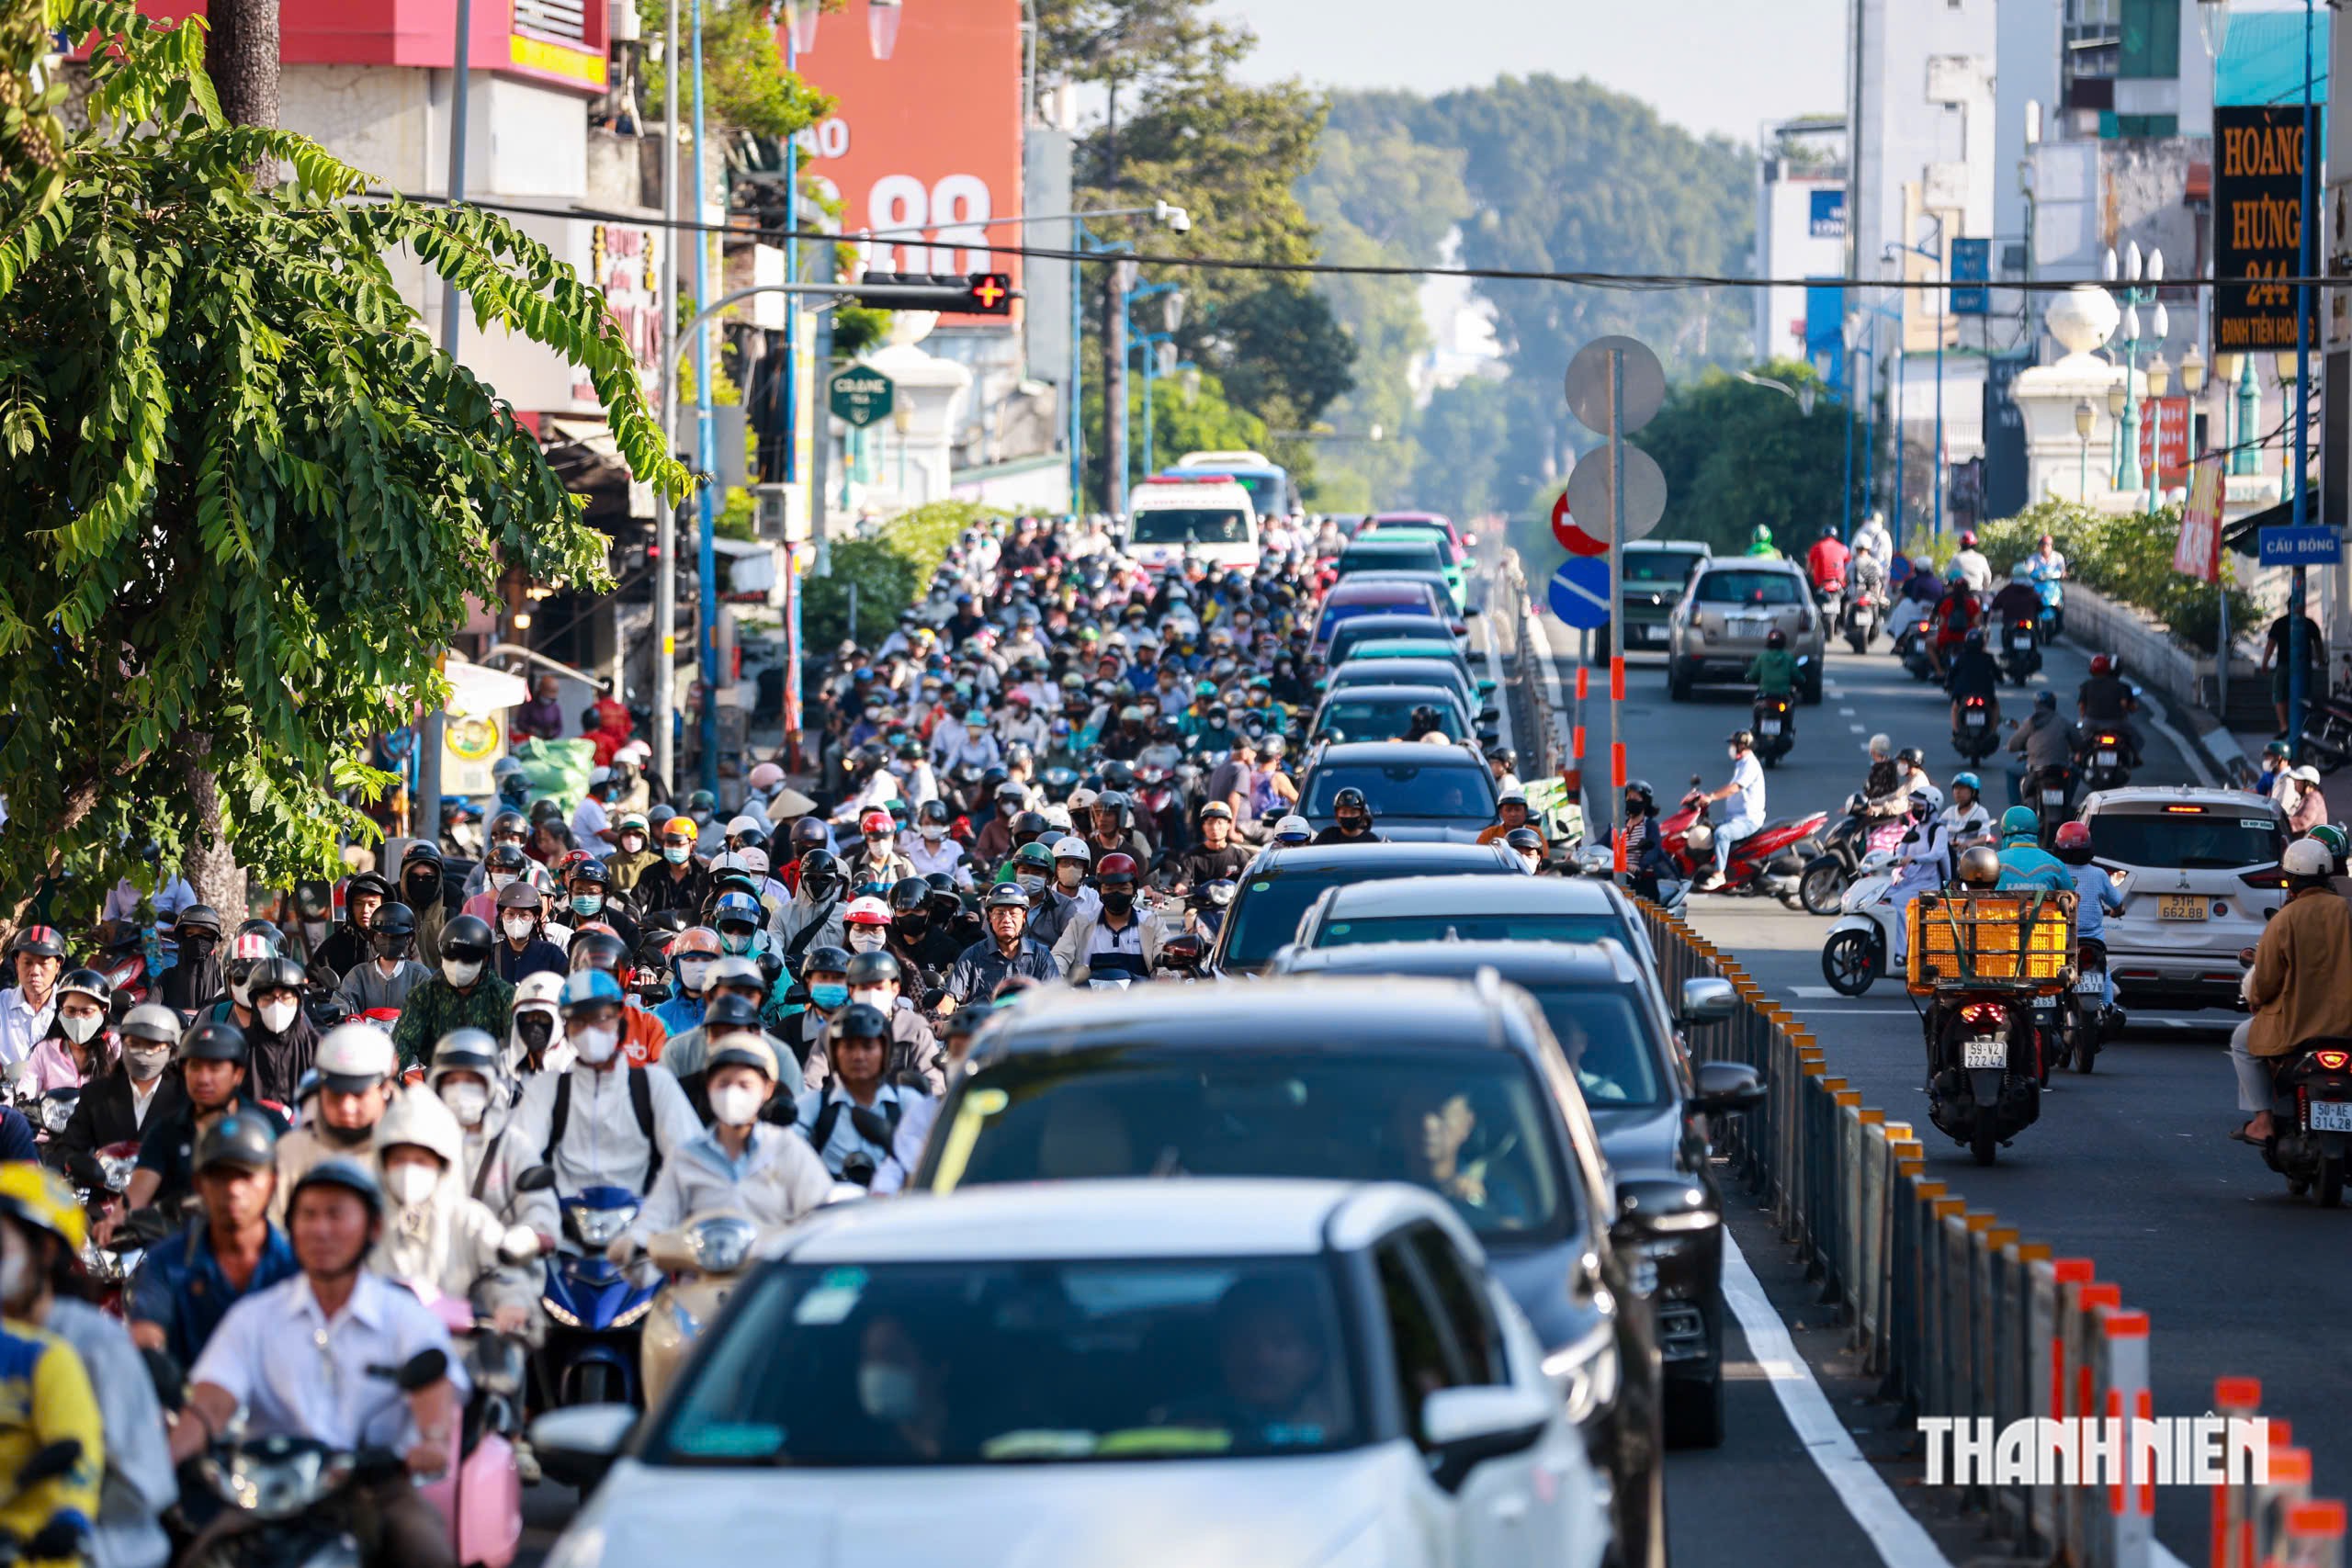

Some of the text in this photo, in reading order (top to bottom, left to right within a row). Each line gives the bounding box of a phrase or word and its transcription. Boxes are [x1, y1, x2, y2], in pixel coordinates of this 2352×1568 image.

[2245, 258, 2290, 307] 244
[2277, 309, 2315, 344] HOÀG
[2298, 535, 2335, 553] BÔNG
[2172, 897, 2195, 907] 51H
[2163, 907, 2203, 918] 662.88
[1971, 1043, 1999, 1055] 59-V2
[1968, 1055, 2003, 1066] 222.42
[2317, 1103, 2349, 1117] 50-AE
[2314, 1116, 2351, 1130] 314.28
